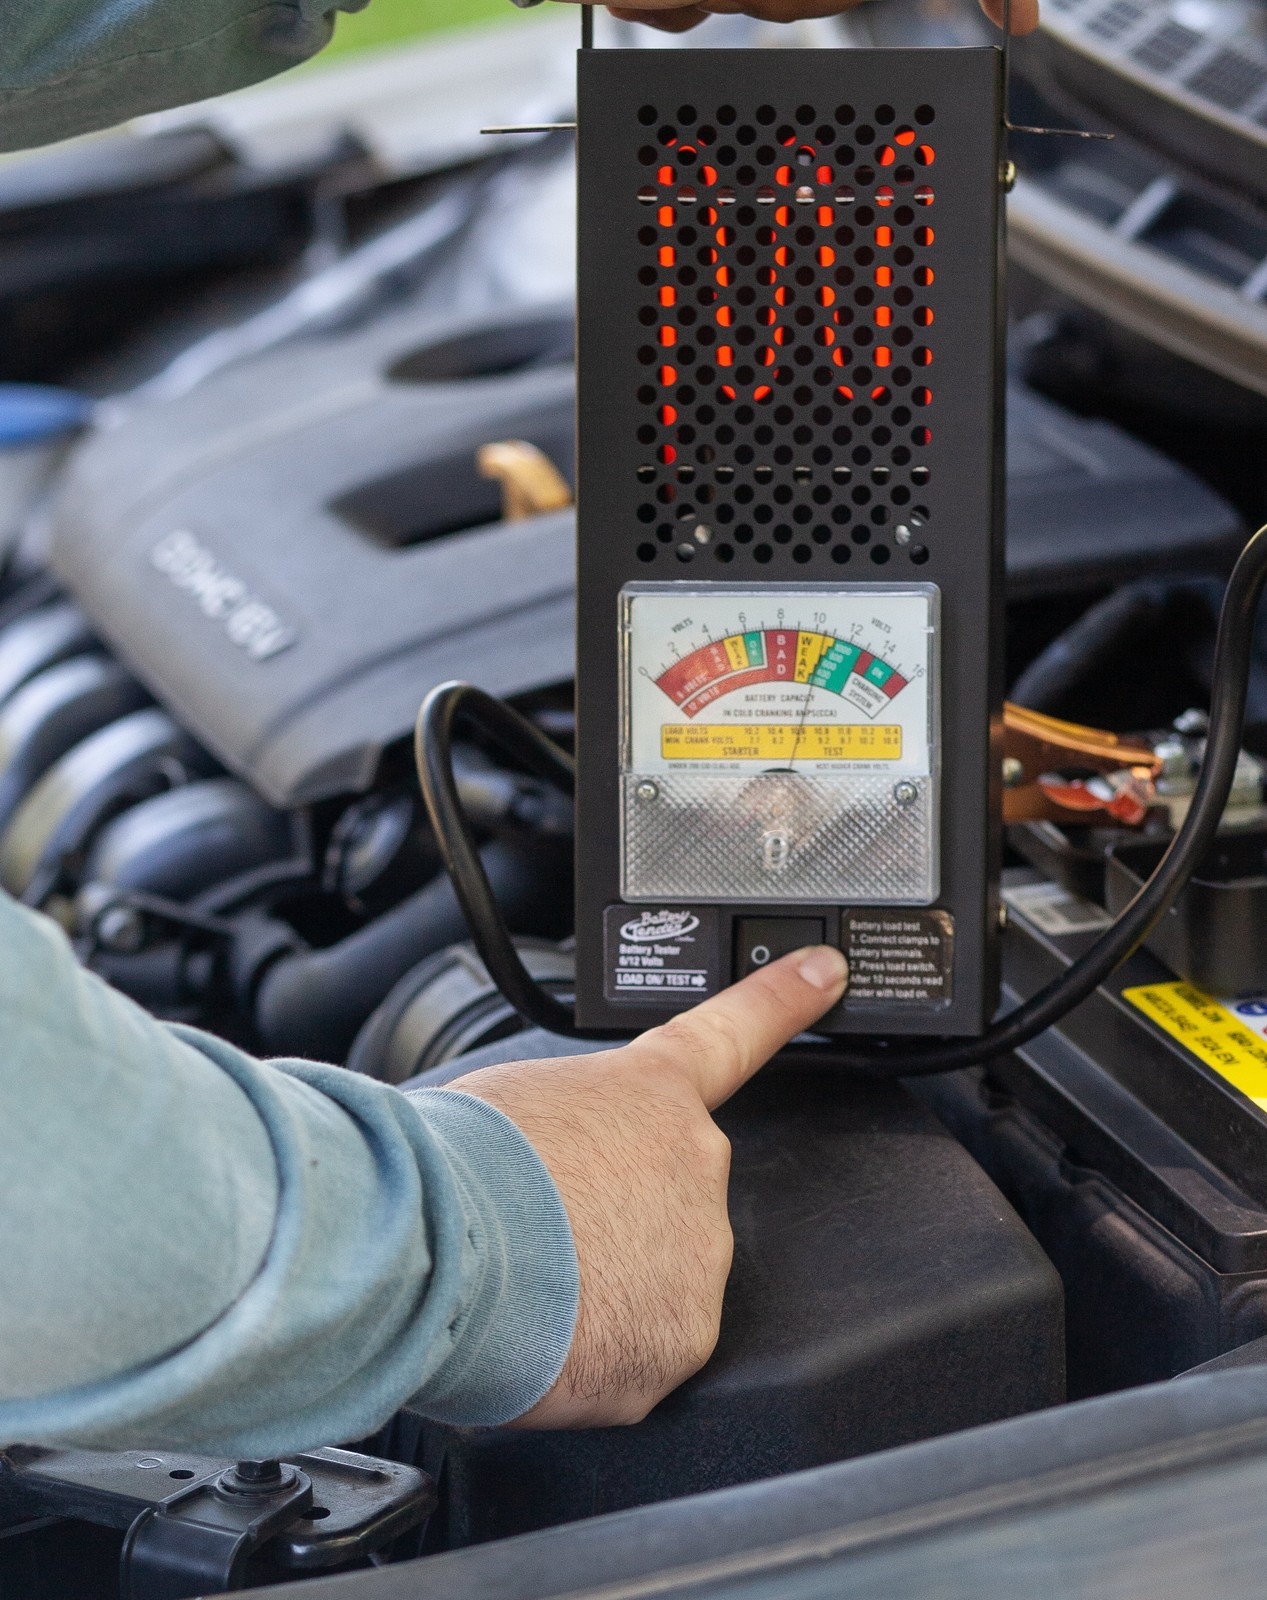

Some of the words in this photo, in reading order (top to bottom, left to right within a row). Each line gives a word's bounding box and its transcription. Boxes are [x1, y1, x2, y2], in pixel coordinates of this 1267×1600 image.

[738, 612, 746, 623] 6
[777, 608, 785, 620] 8
[814, 612, 827, 624] 10
[672, 617, 694, 633] VOLTS
[701, 624, 709, 634] 4
[850, 623, 864, 636] 12
[871, 617, 892, 634] VOLTS
[667, 641, 677, 653] 2
[884, 640, 897, 653] 14
[776, 634, 787, 675] BAD
[797, 636, 812, 679] WEAK
[638, 666, 649, 677] 0
[913, 664, 925, 678] 16
[851, 677, 885, 703] CHARGING
[744, 694, 776, 703] BATTERY
[780, 694, 815, 703] CAPACITY
[848, 689, 874, 710] SYSTEM
[723, 709, 732, 717] IN
[733, 709, 753, 717] COLD
[755, 709, 794, 717] CRANKING
[723, 747, 759, 756] STARTER
[823, 747, 844, 756] TEST
[641, 910, 691, 927] Battery
[627, 922, 683, 939] Tender
[849, 921, 882, 933] Battery
[882, 921, 901, 931] load
[903, 921, 920, 931] test
[851, 934, 859, 944] 1.
[859, 934, 896, 945] Connect
[897, 935, 930, 947] clamps
[930, 936, 940, 945] to
[619, 943, 652, 957] Battery
[653, 944, 681, 955] Tester
[849, 948, 880, 959] battery
[881, 949, 923, 958] terminals.
[619, 956, 640, 967] 6/12
[641, 956, 664, 967] Volts
[859, 962, 885, 972] Press
[886, 962, 906, 972] load
[906, 962, 938, 972] switch.
[617, 973, 644, 985] LOAD
[645, 974, 665, 985] ON/
[666, 974, 690, 986] TEST
[849, 975, 871, 984] After
[872, 975, 883, 985] 10
[885, 975, 922, 985] seconds
[922, 975, 943, 985] read
[849, 989, 875, 998] meter
[876, 988, 895, 998] with
[895, 988, 914, 998] load
[915, 989, 929, 999] on.
